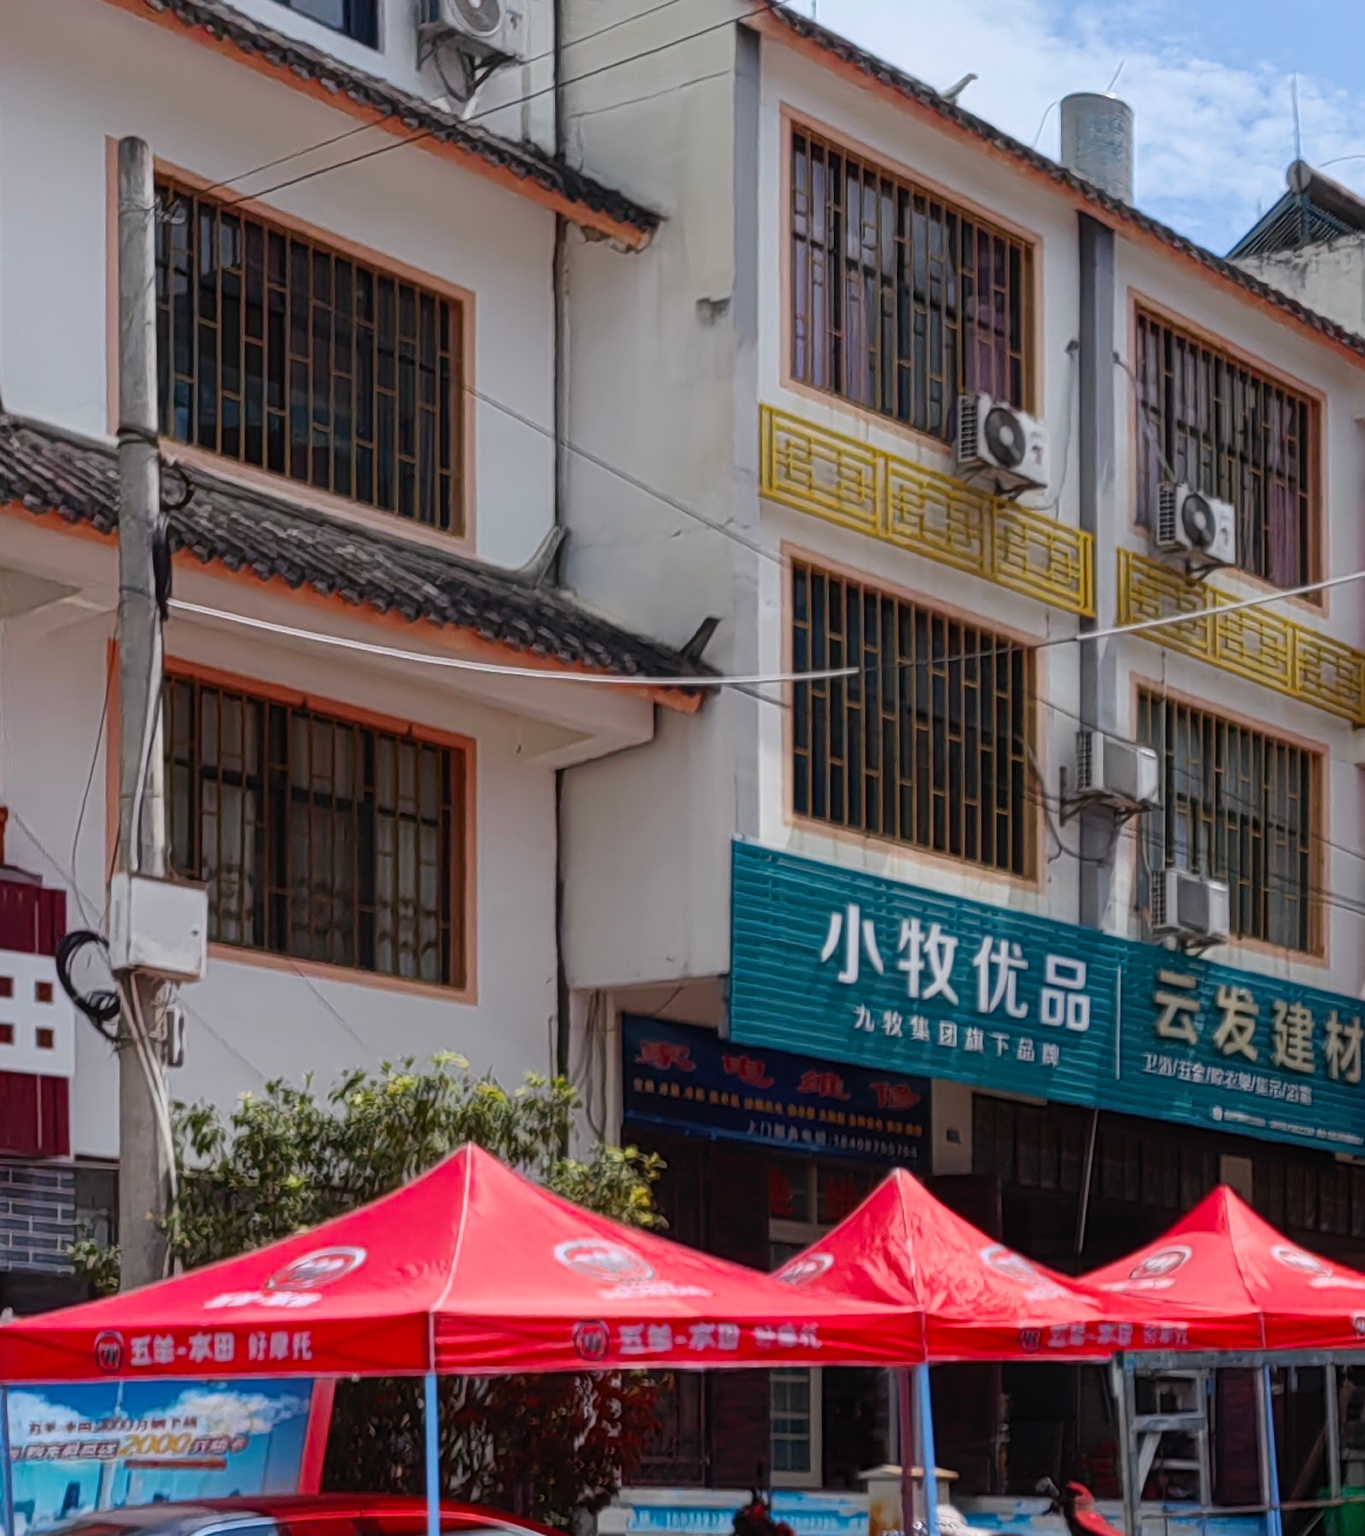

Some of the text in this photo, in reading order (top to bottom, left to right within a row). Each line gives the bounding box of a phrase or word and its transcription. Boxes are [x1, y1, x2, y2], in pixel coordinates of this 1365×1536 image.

[819, 903, 1091, 1033] 小牧优品
[1153, 967, 1365, 1084] 云发建材
[853, 1003, 1060, 1067] 九牧集团旗下品牌
